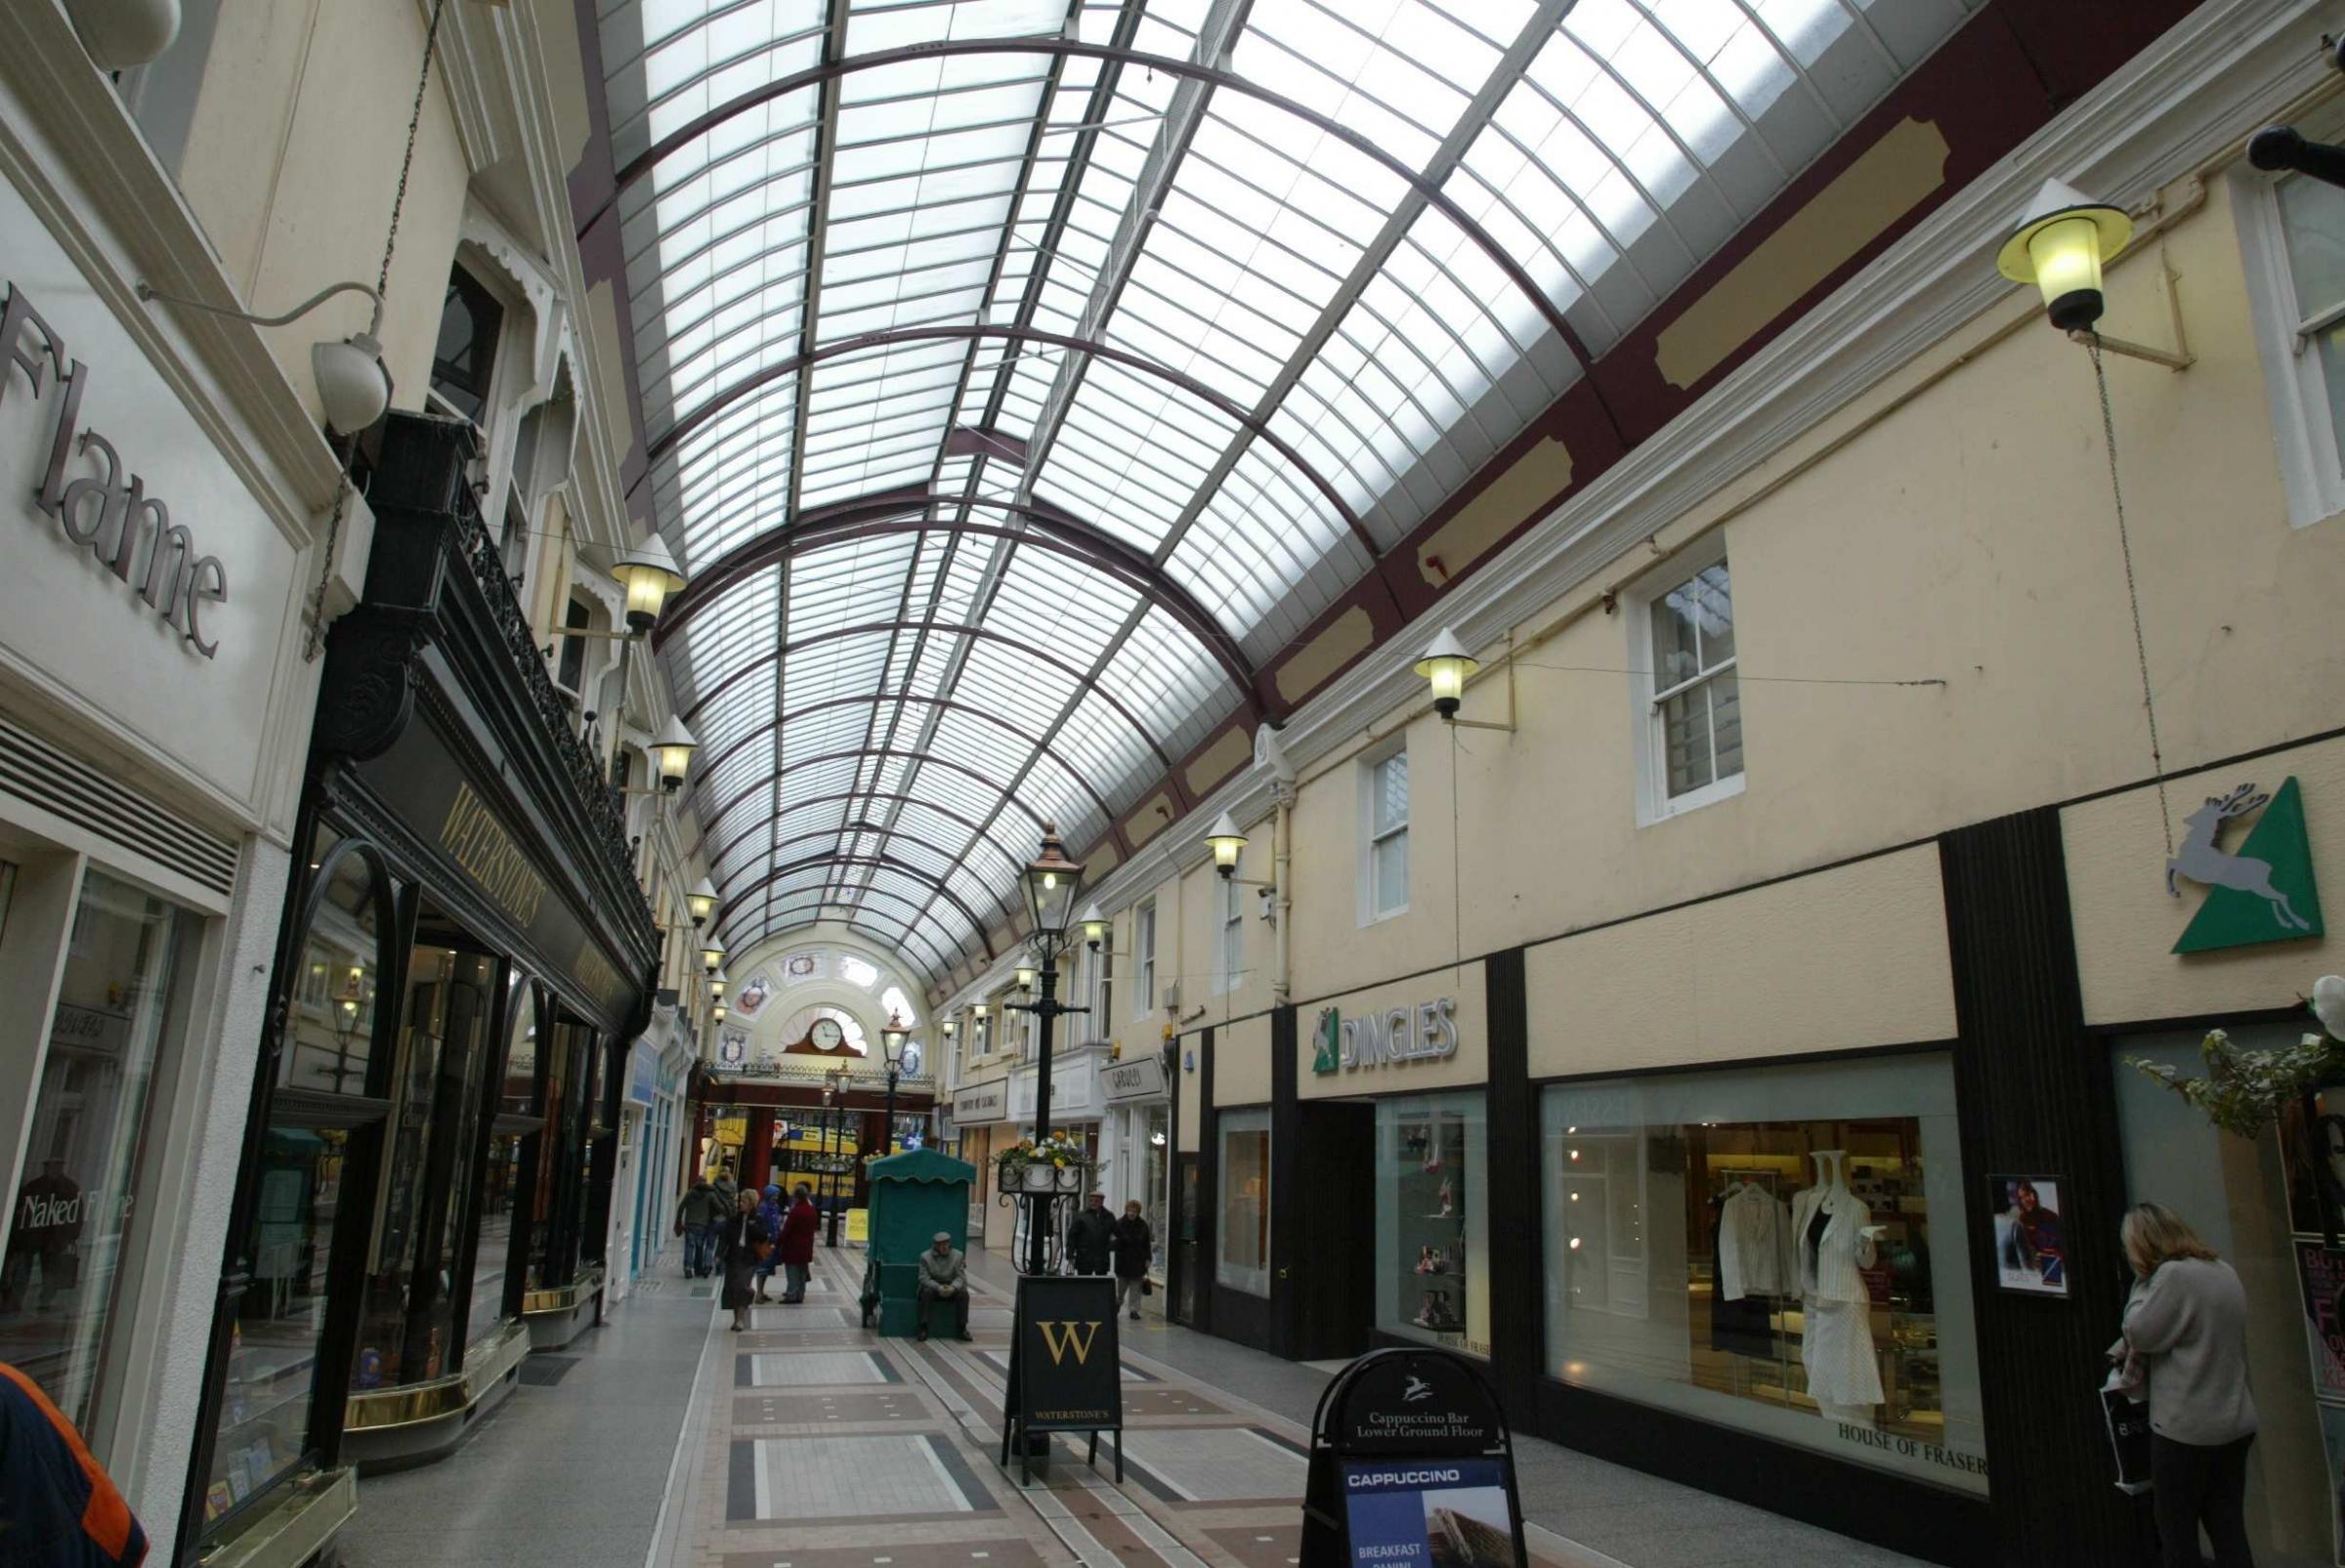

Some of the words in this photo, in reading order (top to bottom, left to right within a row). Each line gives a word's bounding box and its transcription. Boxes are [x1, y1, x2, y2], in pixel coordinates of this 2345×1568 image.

[0, 281, 228, 659] Flame
[1340, 997, 1458, 1068] DINGLES
[20, 1191, 82, 1230] Naked
[1036, 1321, 1102, 1366] W
[1356, 1425, 1397, 1438] Lower
[1399, 1424, 1448, 1438] Ground
[1451, 1424, 1485, 1438] Floor
[1369, 1411, 1445, 1428] Cappuccino
[1446, 1412, 1470, 1424] Bar
[1838, 1422, 1894, 1451] HOUSE
[1897, 1437, 1919, 1457] OF
[1923, 1444, 1989, 1476] FRASER
[1347, 1468, 1461, 1487] CAPPUCCINO
[1358, 1544, 1422, 1559] BREAKFAST
